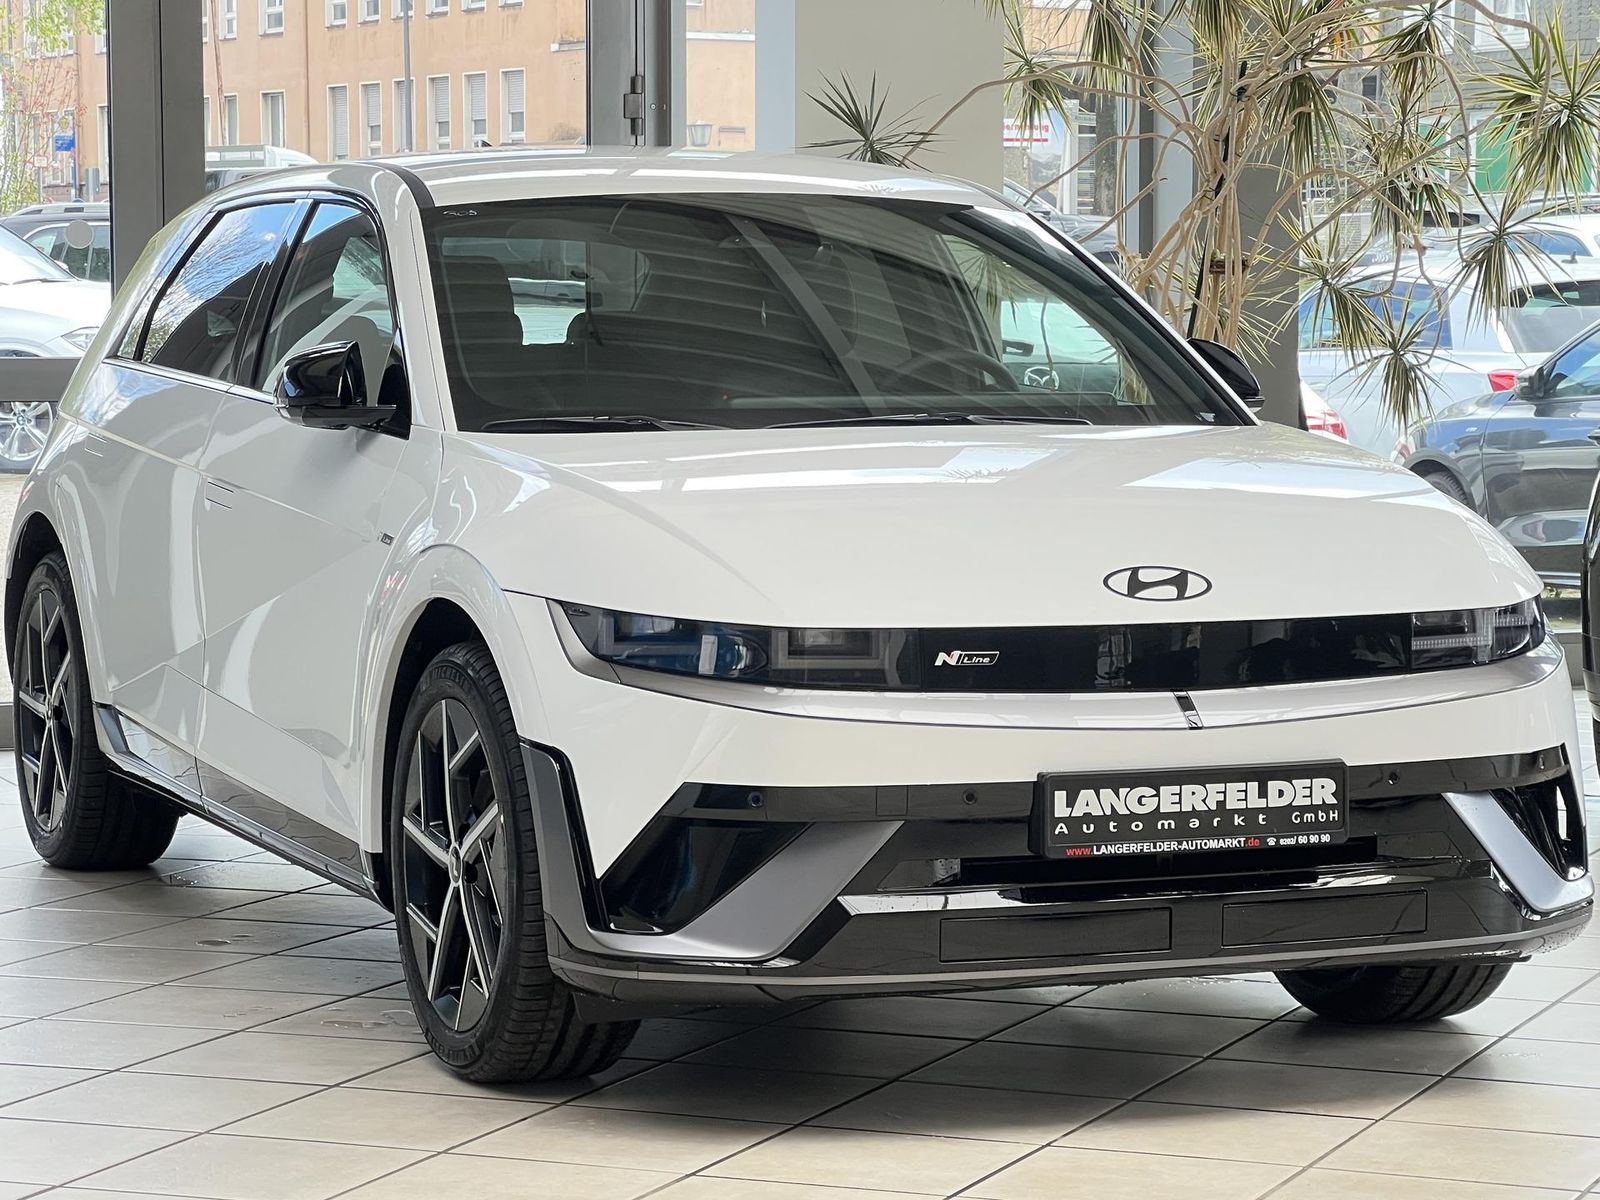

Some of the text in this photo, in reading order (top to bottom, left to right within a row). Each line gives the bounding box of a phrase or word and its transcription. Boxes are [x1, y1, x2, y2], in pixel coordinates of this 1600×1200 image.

[934, 650, 991, 666] N Line
[1054, 778, 1338, 818] LANGERFELDER
[1054, 810, 1339, 835] Automarkt GmbH
[1066, 837, 1260, 856] www.LANGERFELDER-AUTOMARKT.de
[1298, 835, 1308, 845] 60
[1309, 834, 1319, 844] 90
[1320, 833, 1331, 843] 90
